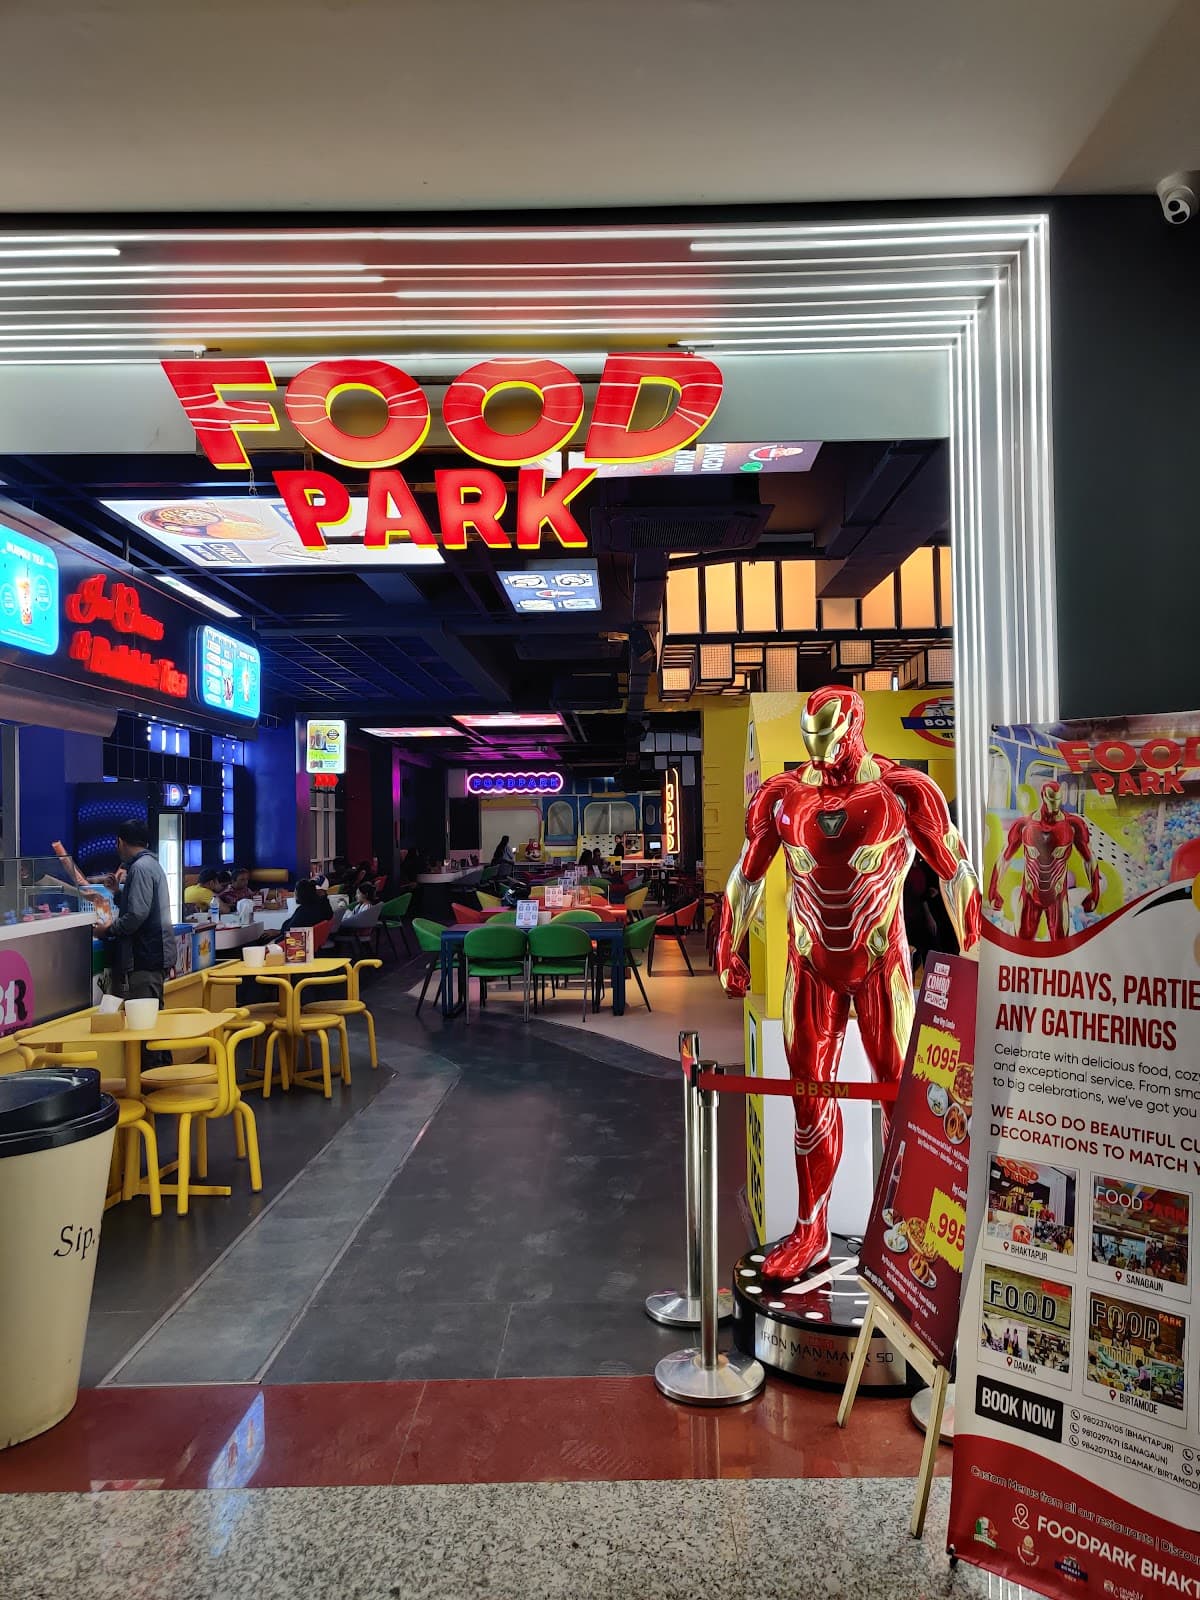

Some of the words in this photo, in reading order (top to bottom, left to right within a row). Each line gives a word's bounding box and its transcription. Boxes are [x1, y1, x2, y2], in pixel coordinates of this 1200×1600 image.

[160, 352, 724, 471] FOOD
[272, 467, 599, 551] PARK
[473, 776, 560, 789] FOODPARK
[1091, 769, 1187, 797] PARK
[998, 965, 1117, 1007] BIRTHDAYS,
[996, 1003, 1037, 1034] ANY
[1042, 1007, 1177, 1051] GATHERINGS
[926, 1043, 958, 1073] 1095
[994, 1043, 1051, 1061] Celebrate
[1054, 1051, 1079, 1065] with
[1081, 1055, 1135, 1073] delicious
[1138, 1061, 1171, 1080] food,
[795, 1082, 849, 1098] BBSM
[993, 1060, 1016, 1074] and
[1018, 1063, 1088, 1083] exceptional
[1090, 1073, 1135, 1090] service.
[1139, 1080, 1171, 1096] From
[993, 1076, 1005, 1088] to
[1007, 1078, 1025, 1093] big
[1028, 1081, 1104, 1104] celebrations,
[1107, 1095, 1143, 1109] we've
[1146, 1101, 1170, 1114] got
[1172, 1105, 1197, 1118] you
[991, 1104, 1014, 1119] WE
[1018, 1109, 1056, 1127] ALSO
[1061, 1116, 1086, 1132] DO
[1090, 1121, 1176, 1149] BEAUTIFUL
[990, 1123, 1099, 1155] DECORATIONS
[1103, 1143, 1125, 1160] TO
[1129, 1148, 1188, 1174] MATCH
[53, 1223, 96, 1261] Sip.
[937, 1212, 965, 1252] 995
[1010, 1244, 1048, 1263] BHAKTAPUR
[990, 1278, 1057, 1323] FOOD
[1126, 1273, 1164, 1293] SANAGAUN
[1090, 1298, 1160, 1341] FOOD
[1158, 1313, 1182, 1328] PARK
[790, 1341, 823, 1359] MAN
[1013, 1359, 1037, 1375] DAMAK
[981, 1386, 1019, 1418] BOOK
[1022, 1400, 1056, 1430] NOW
[1119, 1393, 1158, 1415] BIRTAMODE
[1008, 1478, 1040, 1500] Menus
[1063, 1501, 1077, 1515] all
[1037, 1514, 1137, 1573] FOODPARK
